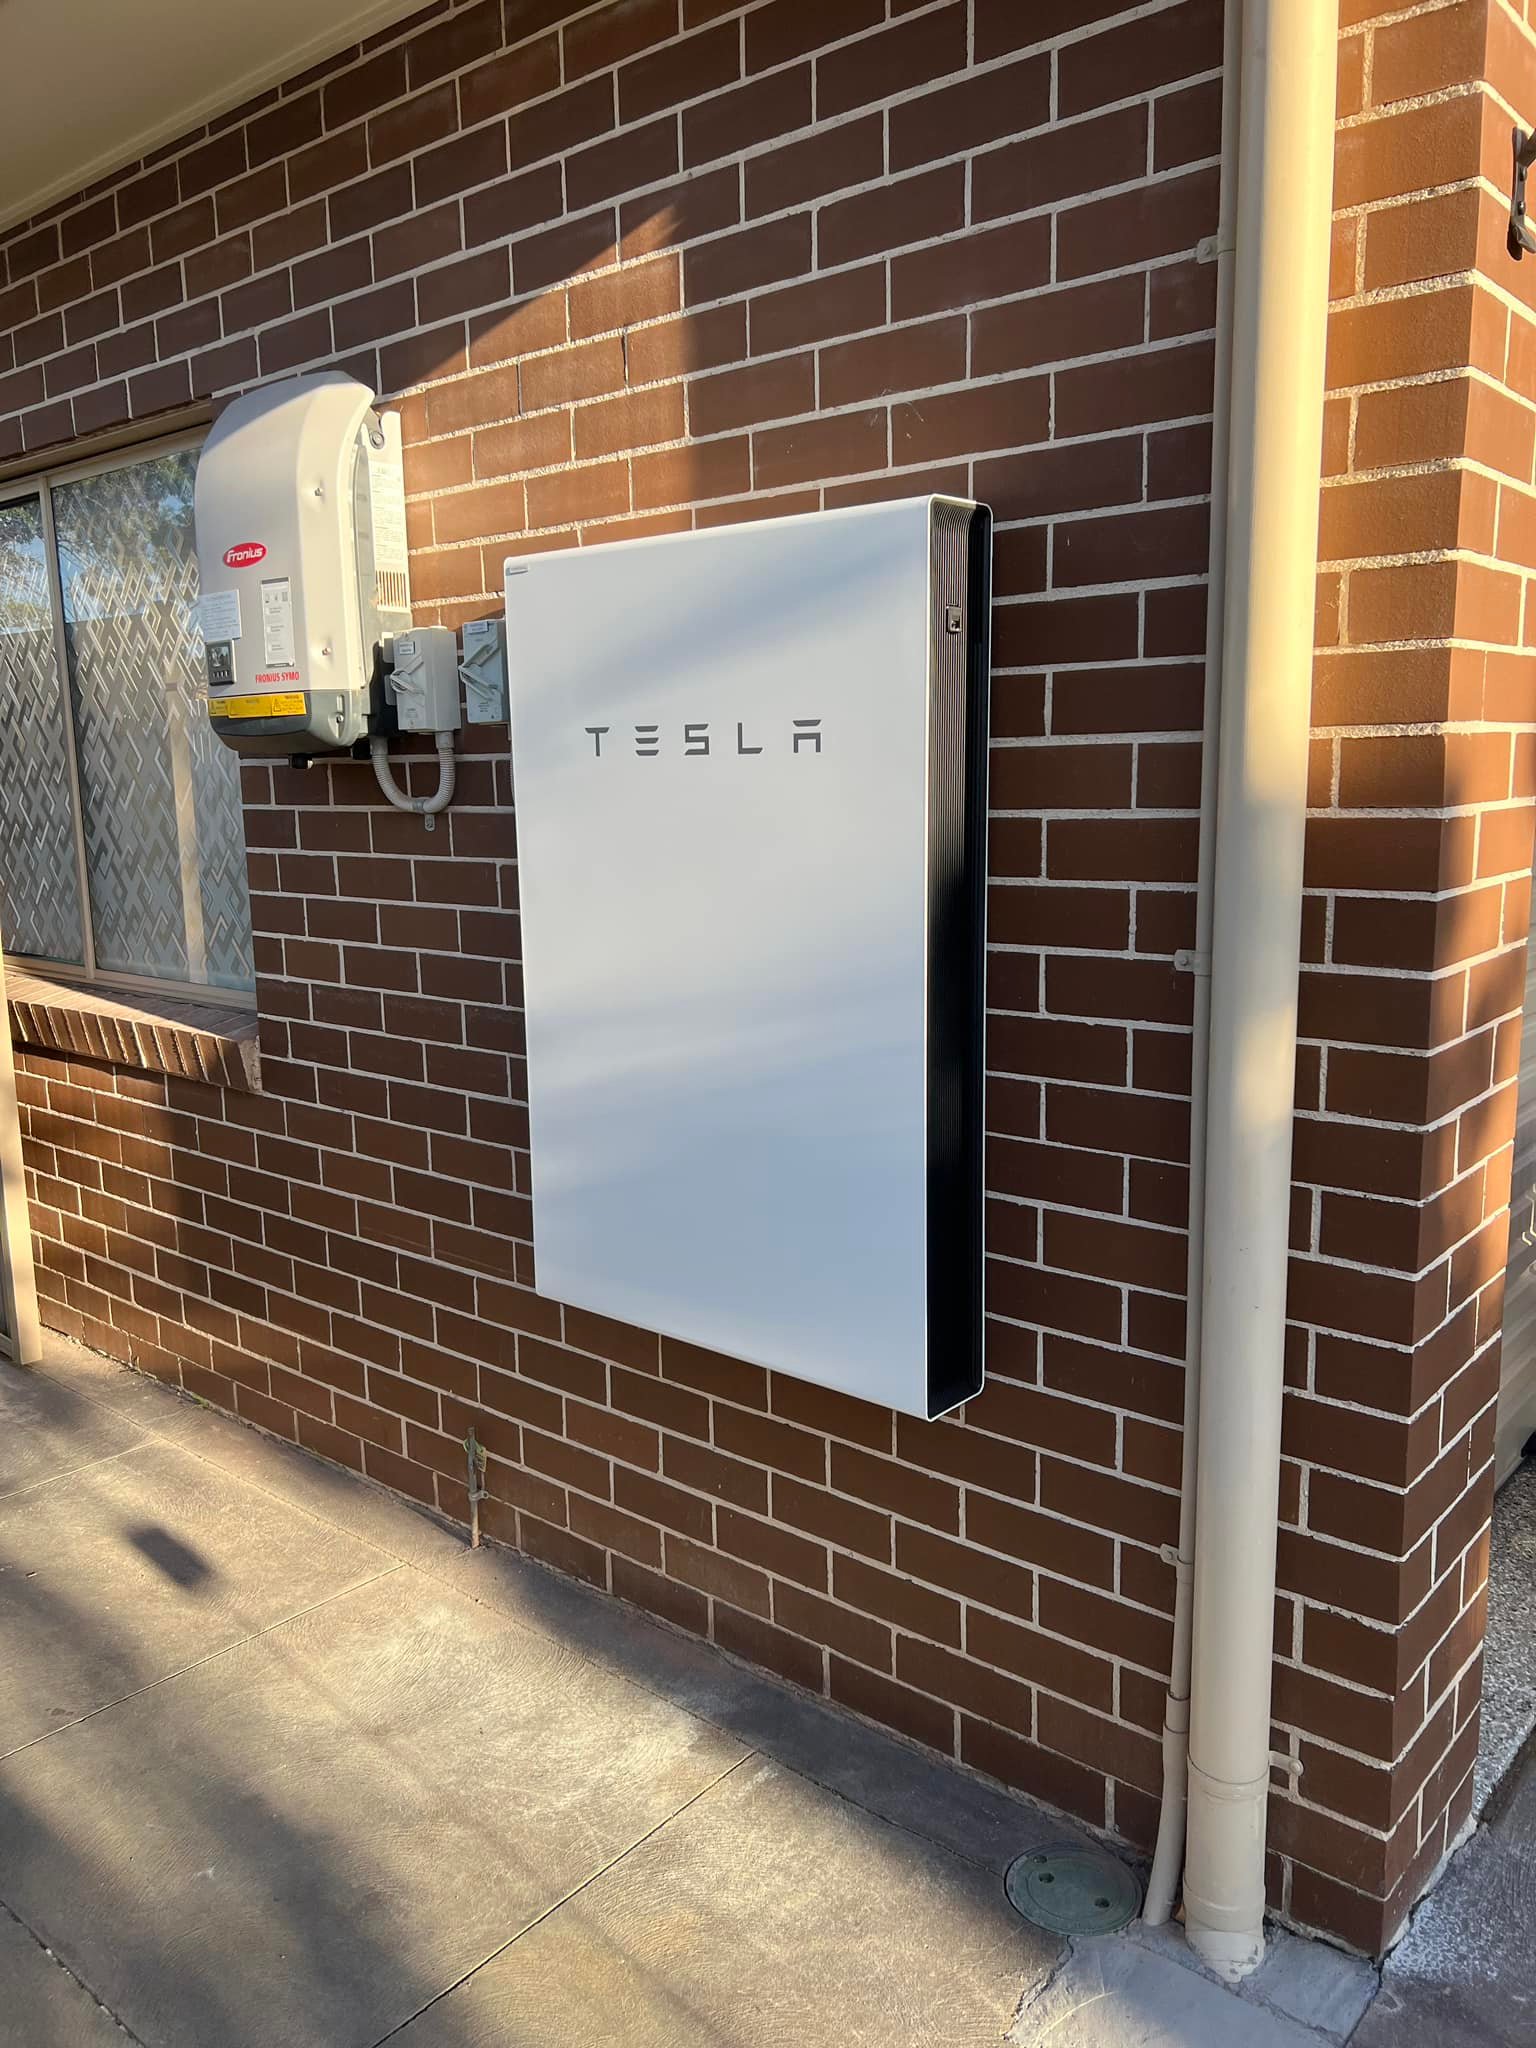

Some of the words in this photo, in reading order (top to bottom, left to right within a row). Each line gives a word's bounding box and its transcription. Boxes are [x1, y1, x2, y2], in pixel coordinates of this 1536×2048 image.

[226, 546, 264, 563] Fronius
[255, 672, 280, 683] FRONIUS
[280, 671, 299, 682] SYMO
[585, 719, 821, 757] TESLA
